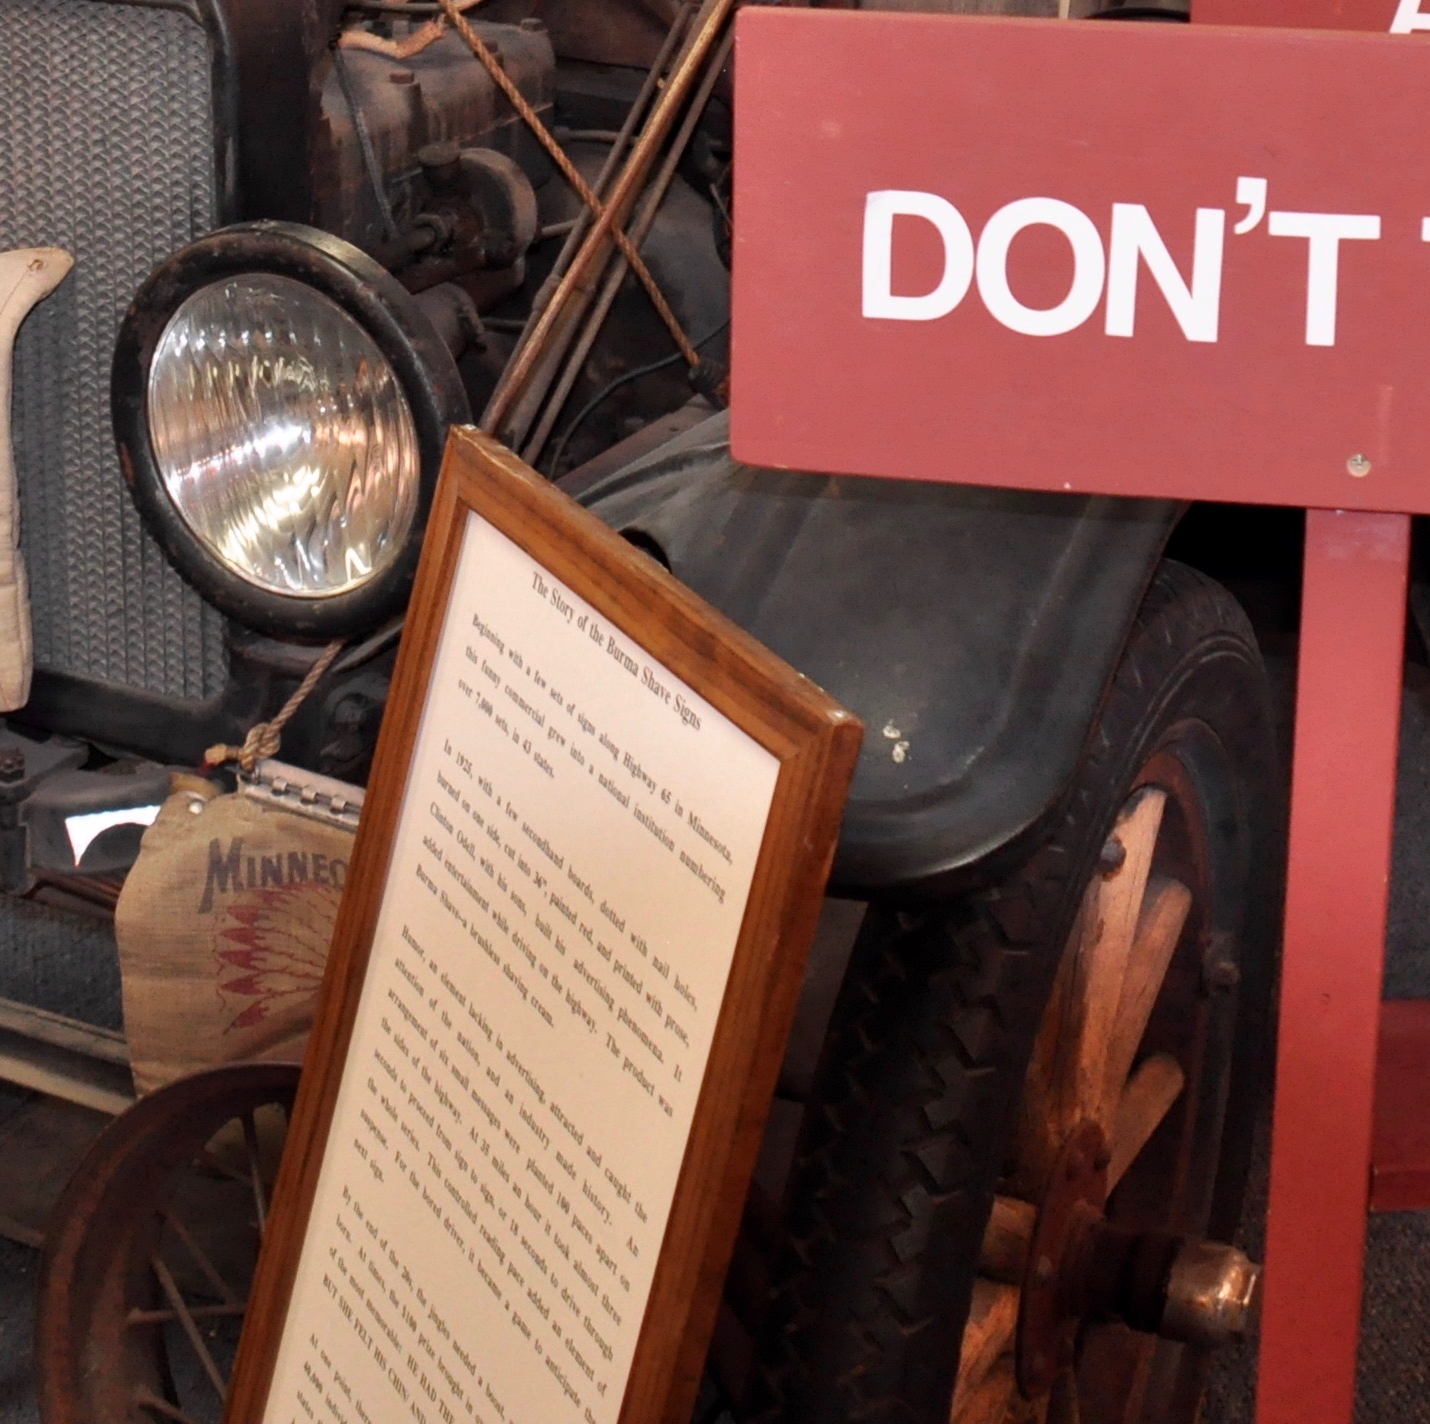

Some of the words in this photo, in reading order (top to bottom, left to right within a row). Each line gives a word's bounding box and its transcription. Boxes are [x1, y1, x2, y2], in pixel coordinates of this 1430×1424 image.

[861, 176, 1381, 349] DON'T
[457, 678, 474, 699] over
[474, 690, 495, 719] 7,000
[493, 713, 510, 738] sets,
[510, 726, 521, 746] in
[521, 737, 533, 756] 43
[532, 750, 556, 780] states.
[530, 570, 550, 600] The
[548, 587, 575, 624] Story
[575, 614, 590, 633] of
[587, 623, 605, 648] the
[605, 635, 640, 679] Burma
[639, 667, 672, 706] Shave
[672, 693, 702, 732] Signs
[464, 644, 479, 666] this
[480, 658, 502, 690] funny
[503, 683, 547, 729] commercial
[546, 724, 567, 748] grew
[568, 741, 586, 767] into
[587, 763, 596, 777] a
[596, 772, 632, 810] national
[632, 802, 676, 854] institution
[678, 849, 727, 906] numbering
[471, 611, 506, 657] Beginning
[507, 647, 525, 670] with
[524, 664, 532, 678] a
[532, 668, 548, 690] few
[548, 686, 565, 707] sets
[565, 702, 577, 718] of
[576, 711, 597, 737] signs
[597, 732, 621, 763] along
[621, 750, 658, 796] Highway
[659, 787, 673, 806] 65
[673, 798, 685, 819] in
[686, 809, 734, 867] Minnesota,
